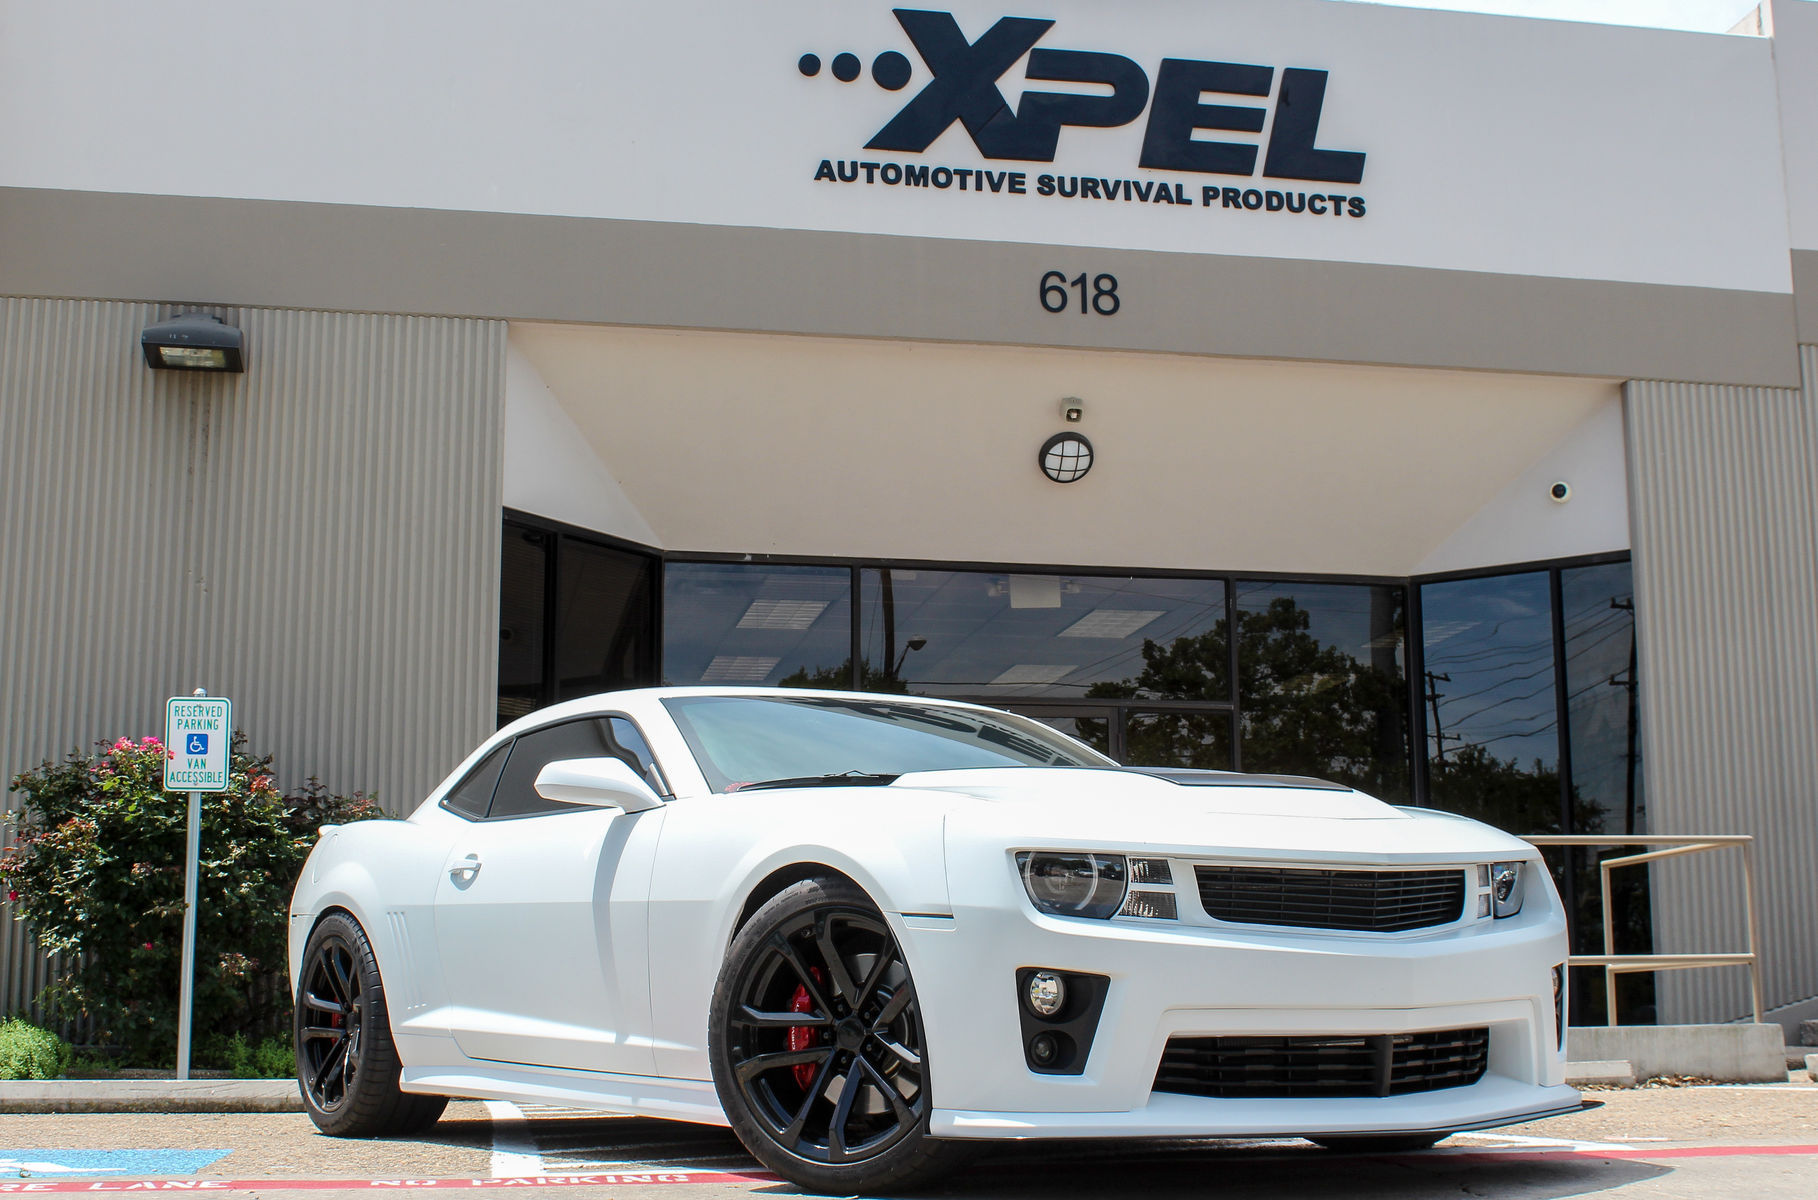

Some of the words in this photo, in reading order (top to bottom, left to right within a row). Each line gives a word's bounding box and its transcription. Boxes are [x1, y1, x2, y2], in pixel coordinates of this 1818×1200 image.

[862, 8, 1367, 184] XPEL
[813, 159, 1027, 195] AUTOMOTIVE
[1036, 174, 1193, 206] SURVIVAL
[1202, 186, 1367, 218] PRODUCTS
[1039, 271, 1120, 316] 618
[174, 705, 223, 717] RESERVED
[177, 719, 219, 730] PARKING
[187, 758, 207, 770] VAN
[169, 771, 223, 783] ACCESSIBLE
[88, 1180, 232, 1190] LANE
[472, 1174, 689, 1186] PARKING
